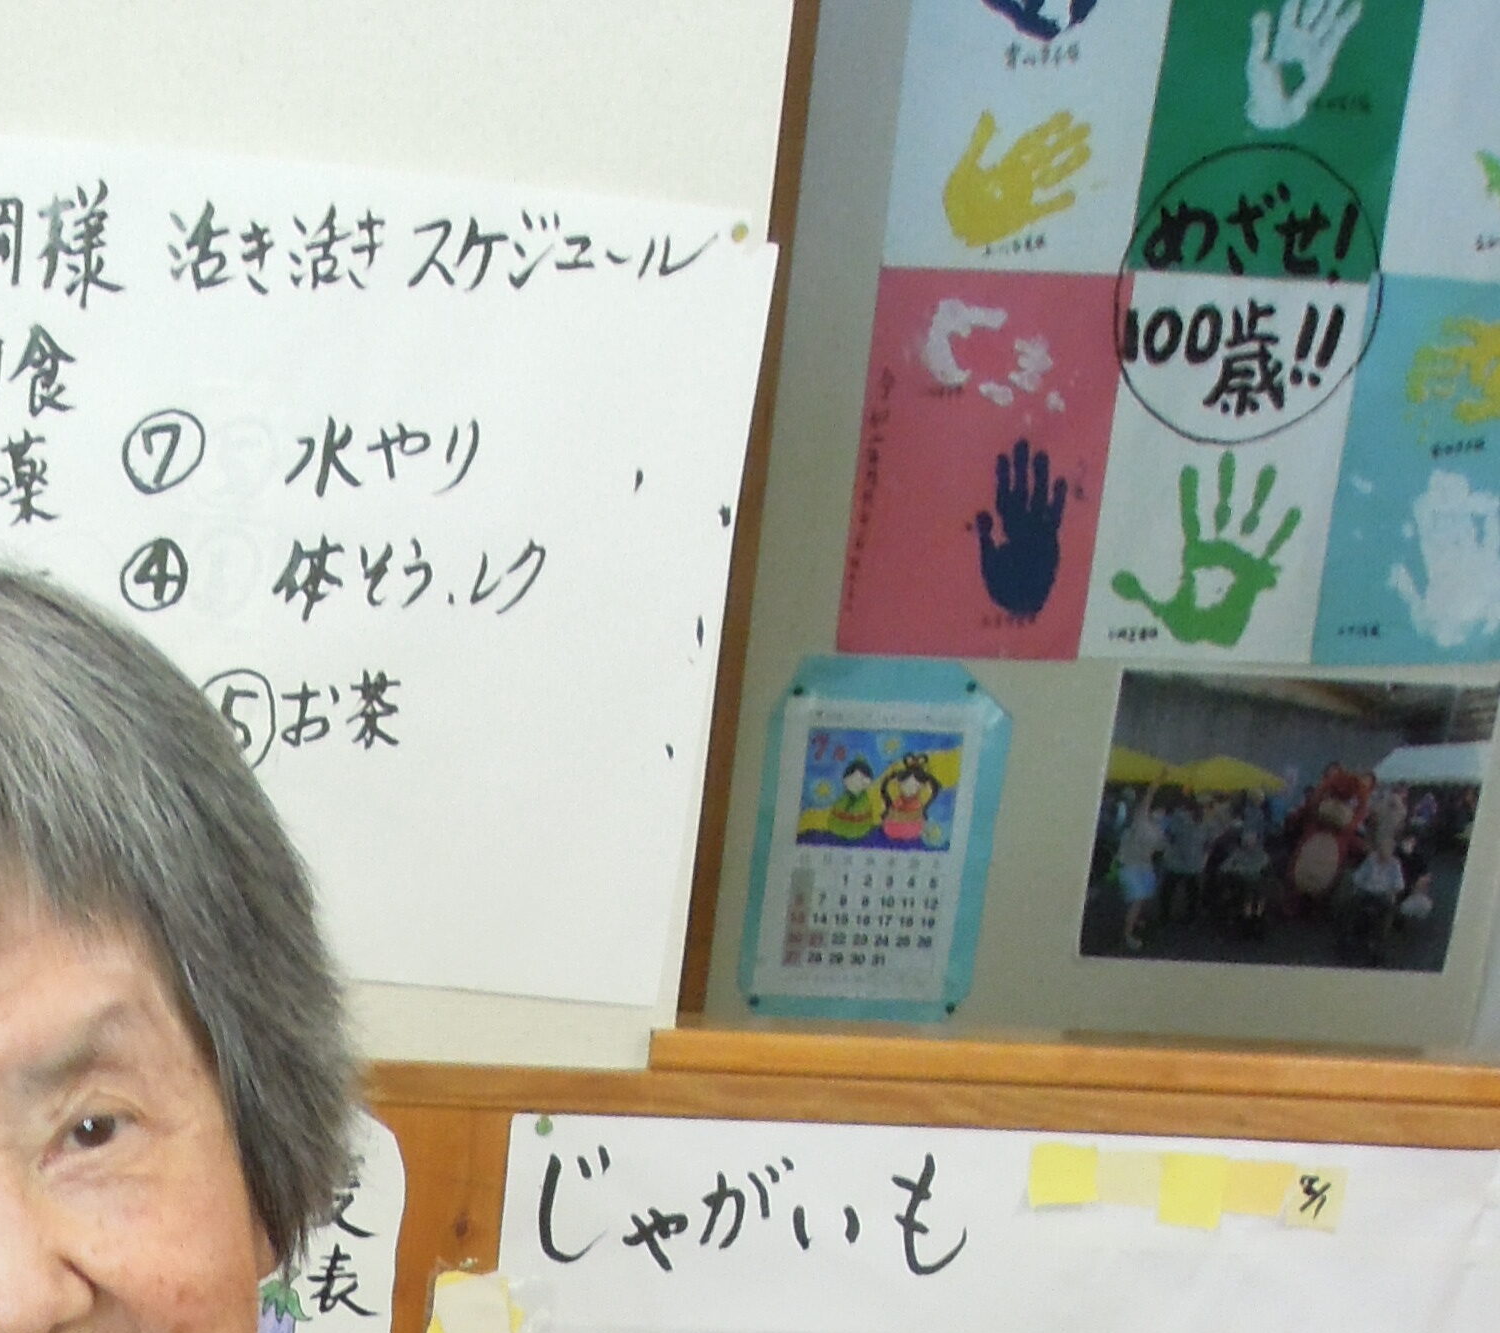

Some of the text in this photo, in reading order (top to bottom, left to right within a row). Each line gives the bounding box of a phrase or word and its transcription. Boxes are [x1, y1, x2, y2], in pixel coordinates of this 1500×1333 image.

[169, 198, 385, 297] 活き活き
[408, 208, 720, 292] スケジュール
[284, 415, 480, 498] 水やり
[539, 1145, 967, 1276] じゃがいも
